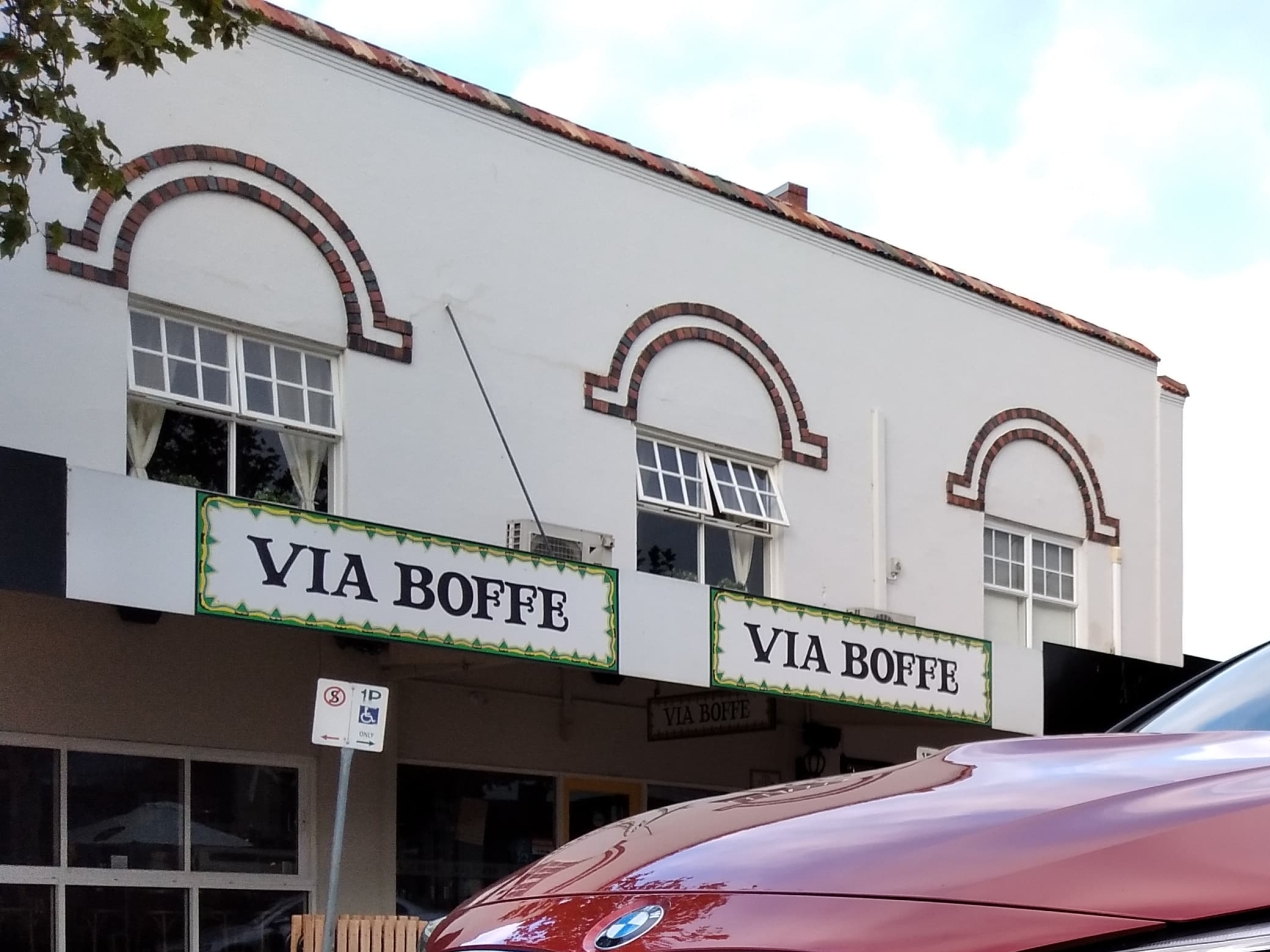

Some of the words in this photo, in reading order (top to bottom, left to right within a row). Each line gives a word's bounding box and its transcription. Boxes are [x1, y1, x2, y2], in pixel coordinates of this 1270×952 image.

[247, 534, 378, 602] VIA
[393, 561, 569, 632] BOFFE
[743, 622, 831, 674] VIA
[840, 640, 959, 695] BOFFE
[361, 688, 382, 702] 1P
[663, 706, 695, 726] VIA
[699, 699, 750, 723] BOFFE
